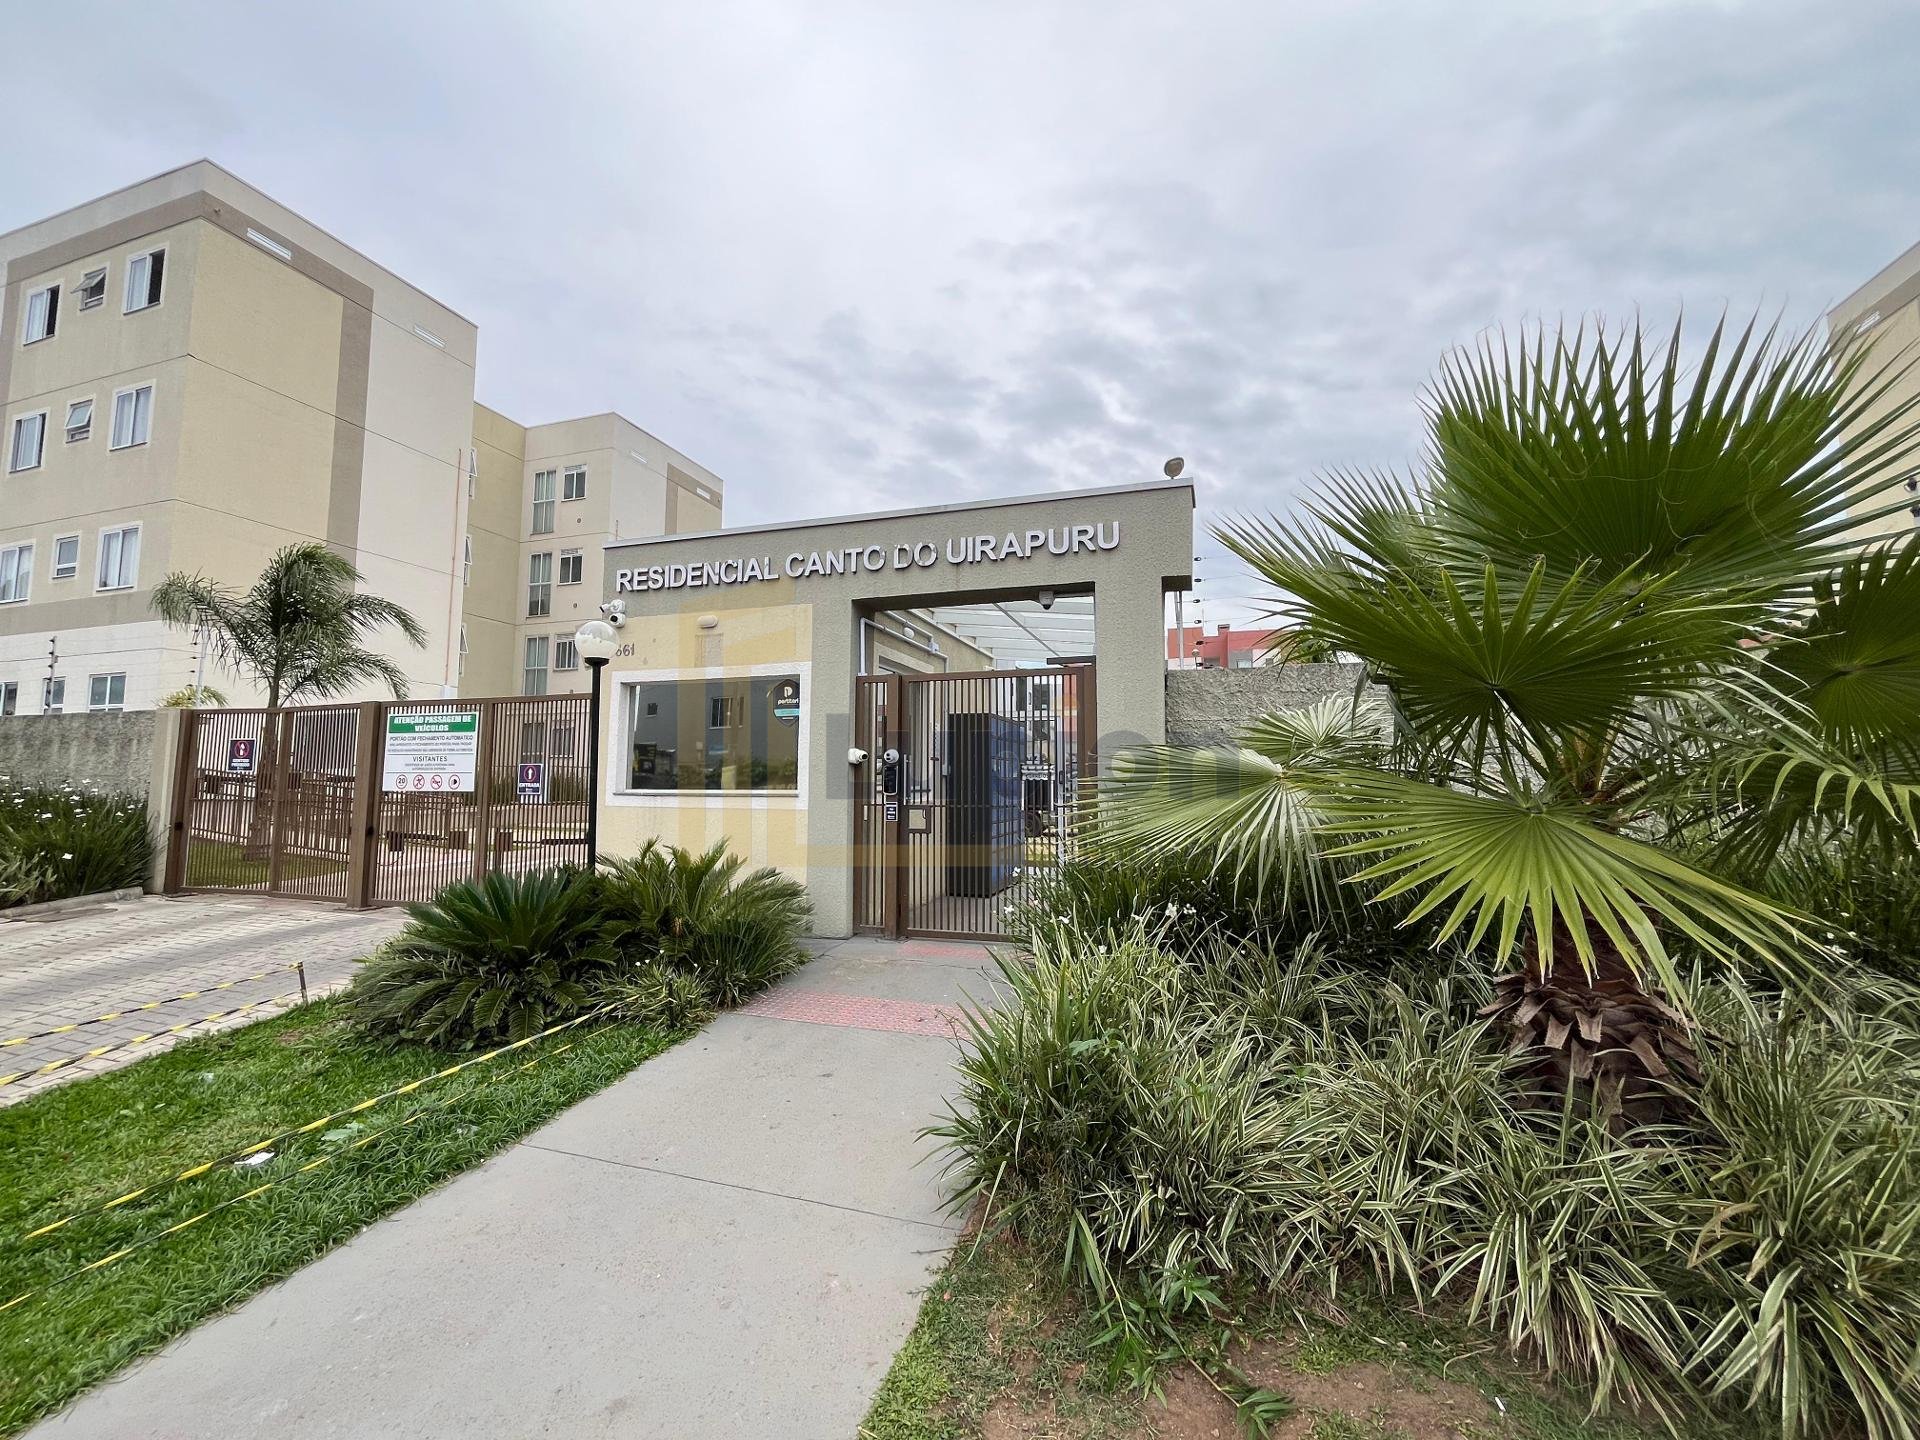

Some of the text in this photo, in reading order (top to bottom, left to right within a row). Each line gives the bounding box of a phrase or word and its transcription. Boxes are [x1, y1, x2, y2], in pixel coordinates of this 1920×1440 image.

[616, 521, 1120, 593] RESIDENCIAL CANTO DO UIRAPURU
[425, 715, 461, 724] PASSAGEM
[415, 724, 449, 732] VEÍCULOS
